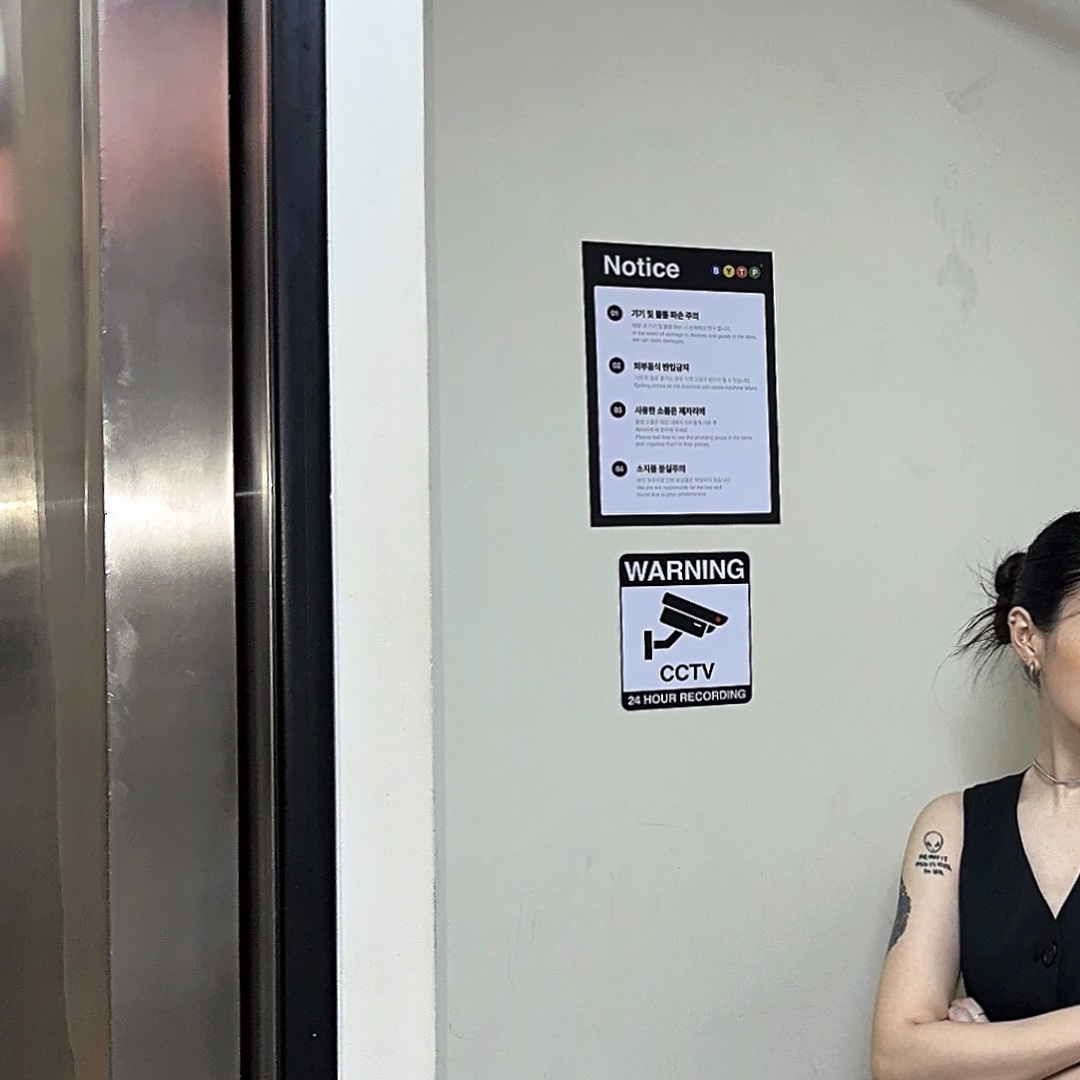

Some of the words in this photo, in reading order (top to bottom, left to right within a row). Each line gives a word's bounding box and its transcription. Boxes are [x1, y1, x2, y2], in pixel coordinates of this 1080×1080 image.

[603, 254, 680, 279] Notice
[631, 309, 646, 319] 기기
[646, 310, 654, 320] 및
[670, 311, 684, 320] 파손
[685, 312, 699, 320] 주의
[634, 406, 656, 415] 사용한
[679, 407, 706, 416] 제자리에
[658, 464, 686, 473] 분실주의
[624, 558, 745, 581] WARNING
[660, 663, 715, 682] CCTV
[627, 696, 641, 706] 24
[643, 693, 677, 705] HOUR
[679, 689, 746, 703] RECORDING
